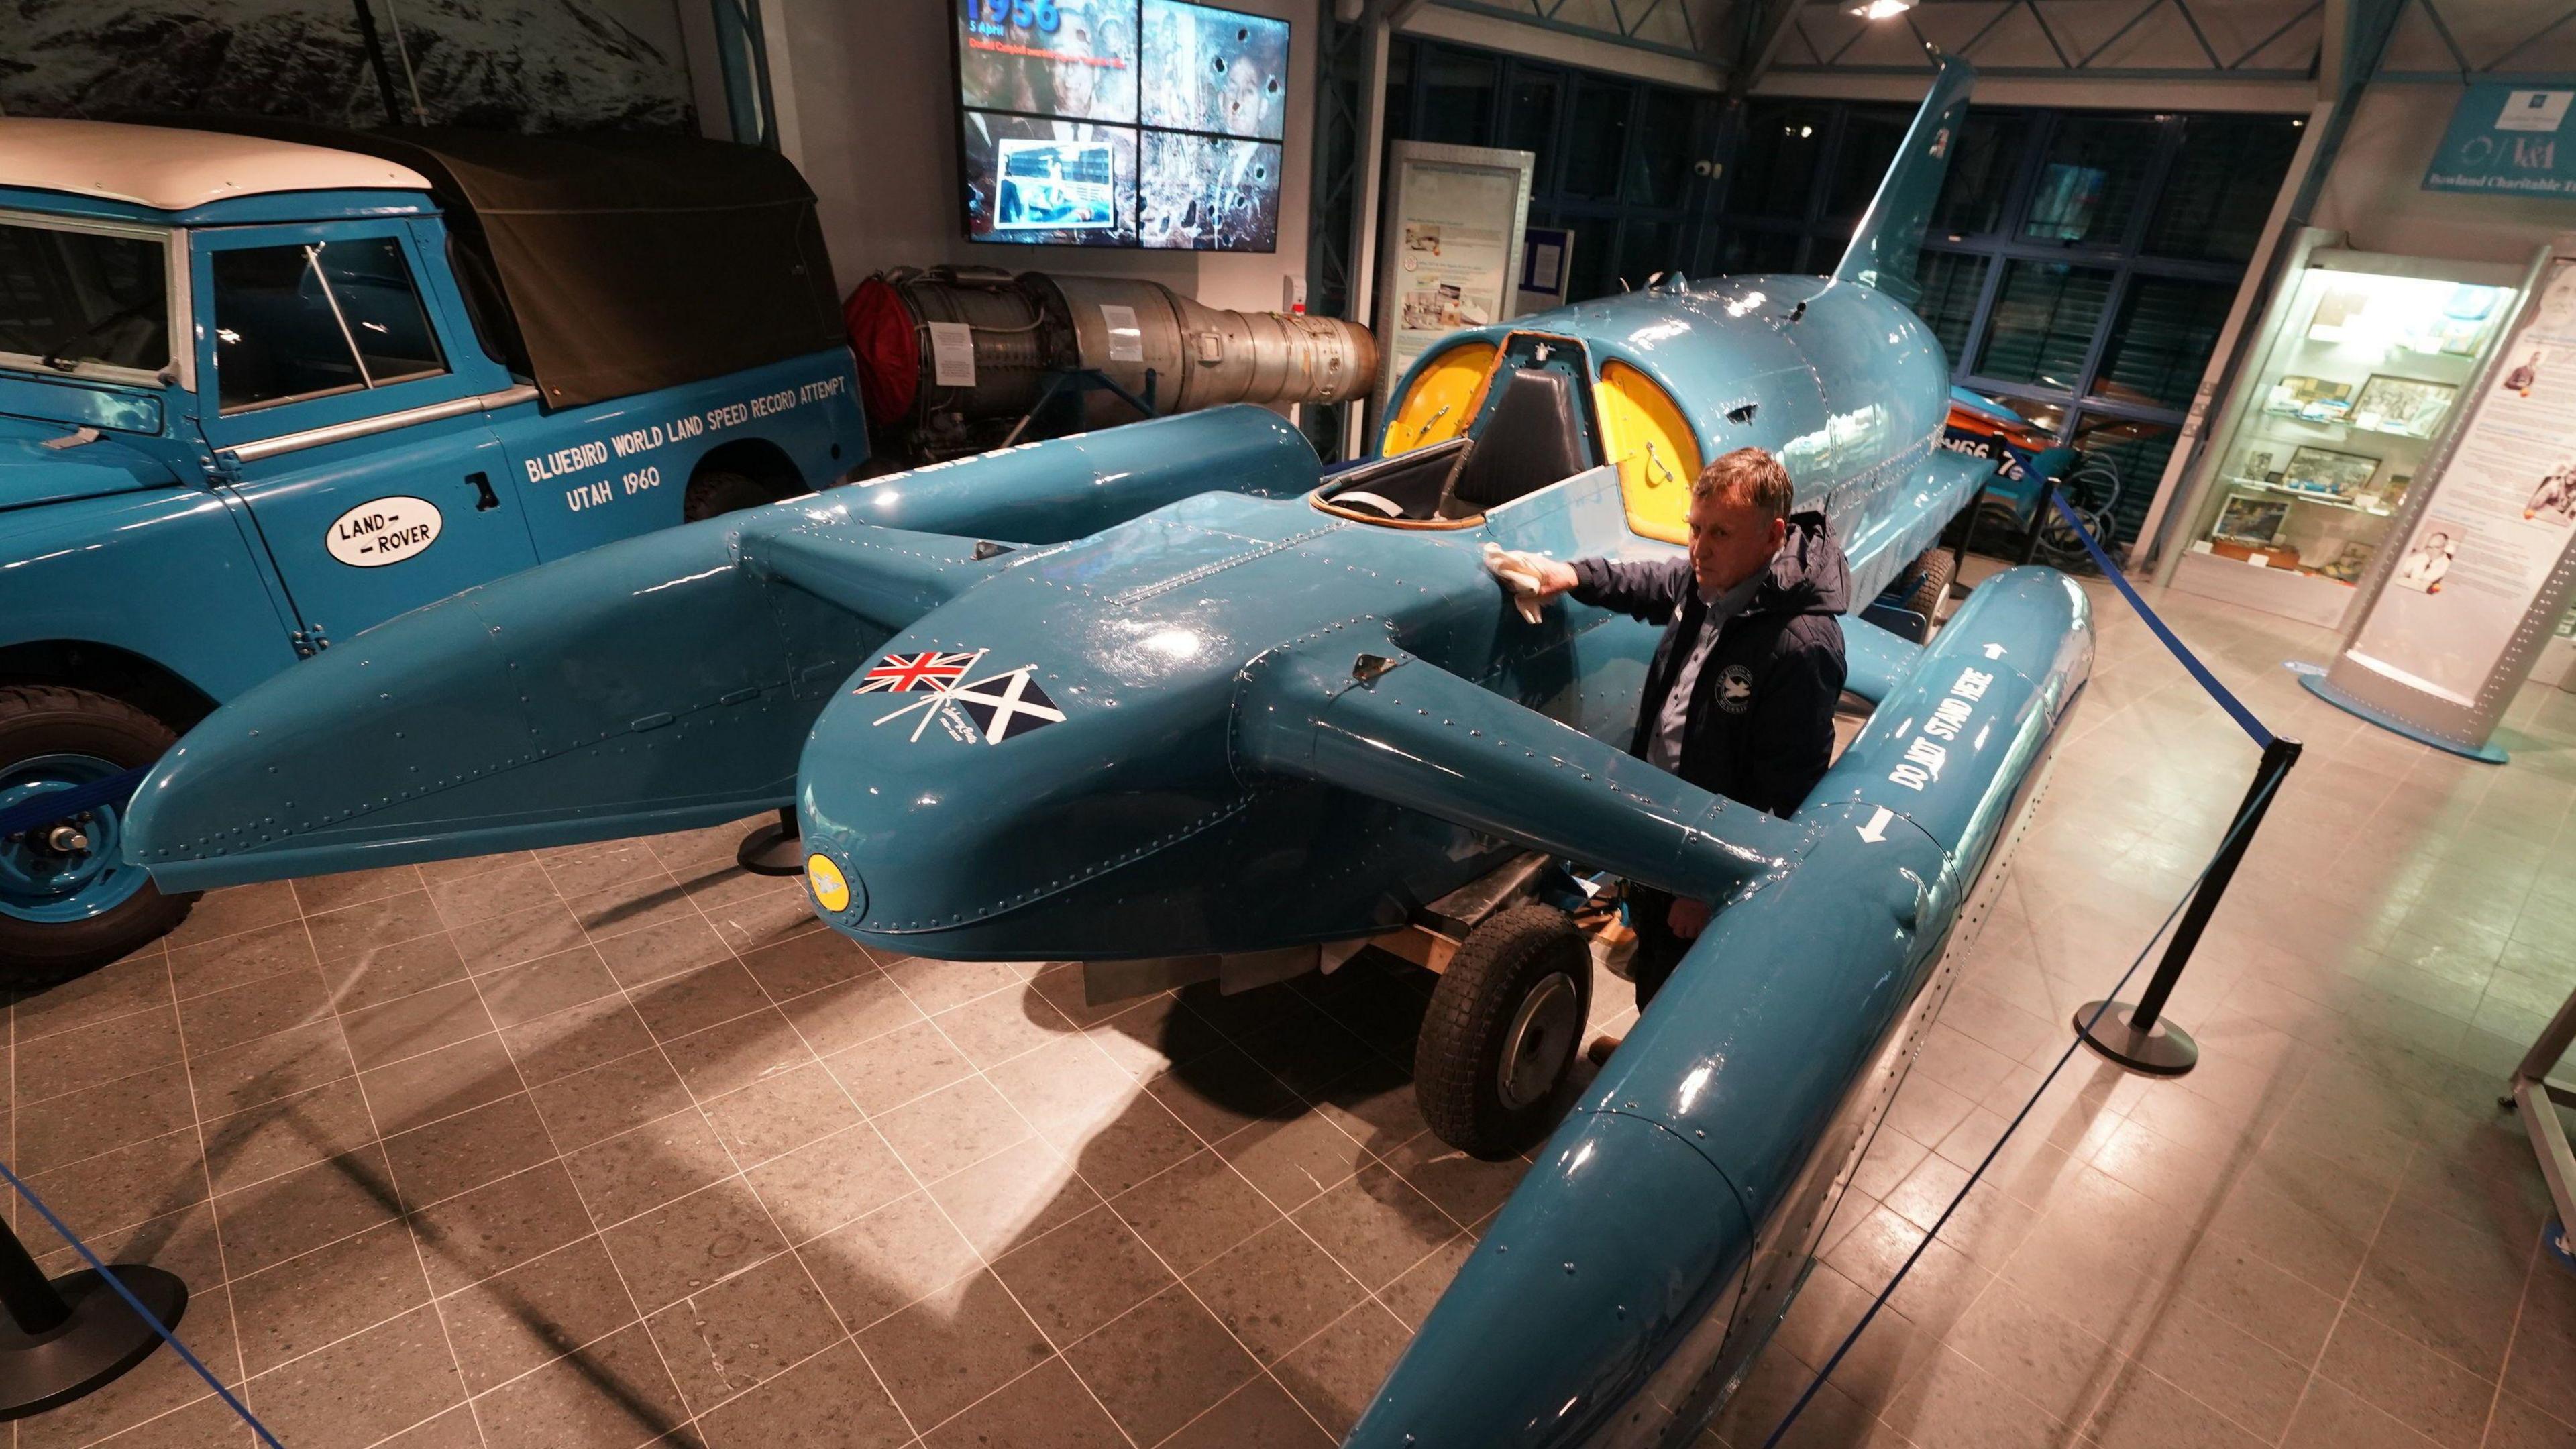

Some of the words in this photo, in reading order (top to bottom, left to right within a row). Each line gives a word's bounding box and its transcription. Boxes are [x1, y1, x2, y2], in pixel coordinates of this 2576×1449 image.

[967, 0, 1061, 32] 1956
[978, 22, 1004, 37] April
[525, 441, 608, 483] BLUEBIRD
[611, 426, 663, 458] WORLD
[666, 415, 704, 443] LAND
[707, 403, 748, 430] SPEED
[751, 390, 796, 418] RECORD
[800, 376, 845, 404] ATTEMPT
[566, 480, 613, 511] UTAH
[623, 466, 660, 495] 1960
[1950, 667, 1994, 702] HERE
[1923, 698, 1973, 741] STAND
[1904, 736, 1947, 769] NOT
[1888, 763, 1929, 792] DO
